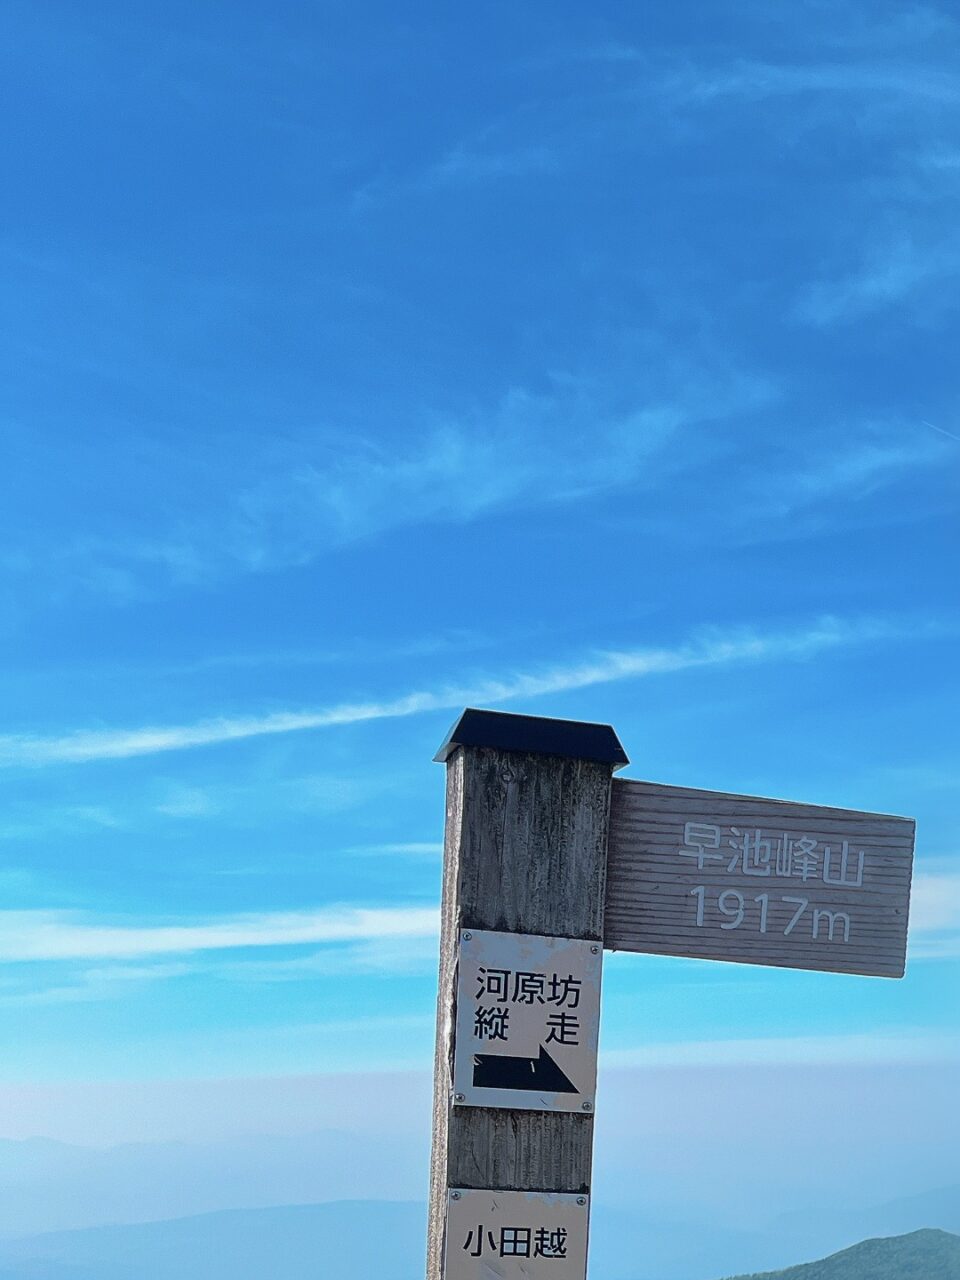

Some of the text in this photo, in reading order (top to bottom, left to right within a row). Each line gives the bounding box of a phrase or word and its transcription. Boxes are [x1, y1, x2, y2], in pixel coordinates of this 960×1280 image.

[678, 821, 865, 887] 早池峰山
[690, 885, 850, 942] 1917m
[475, 966, 582, 1008] 河原坊
[463, 1224, 568, 1259] 小田越
